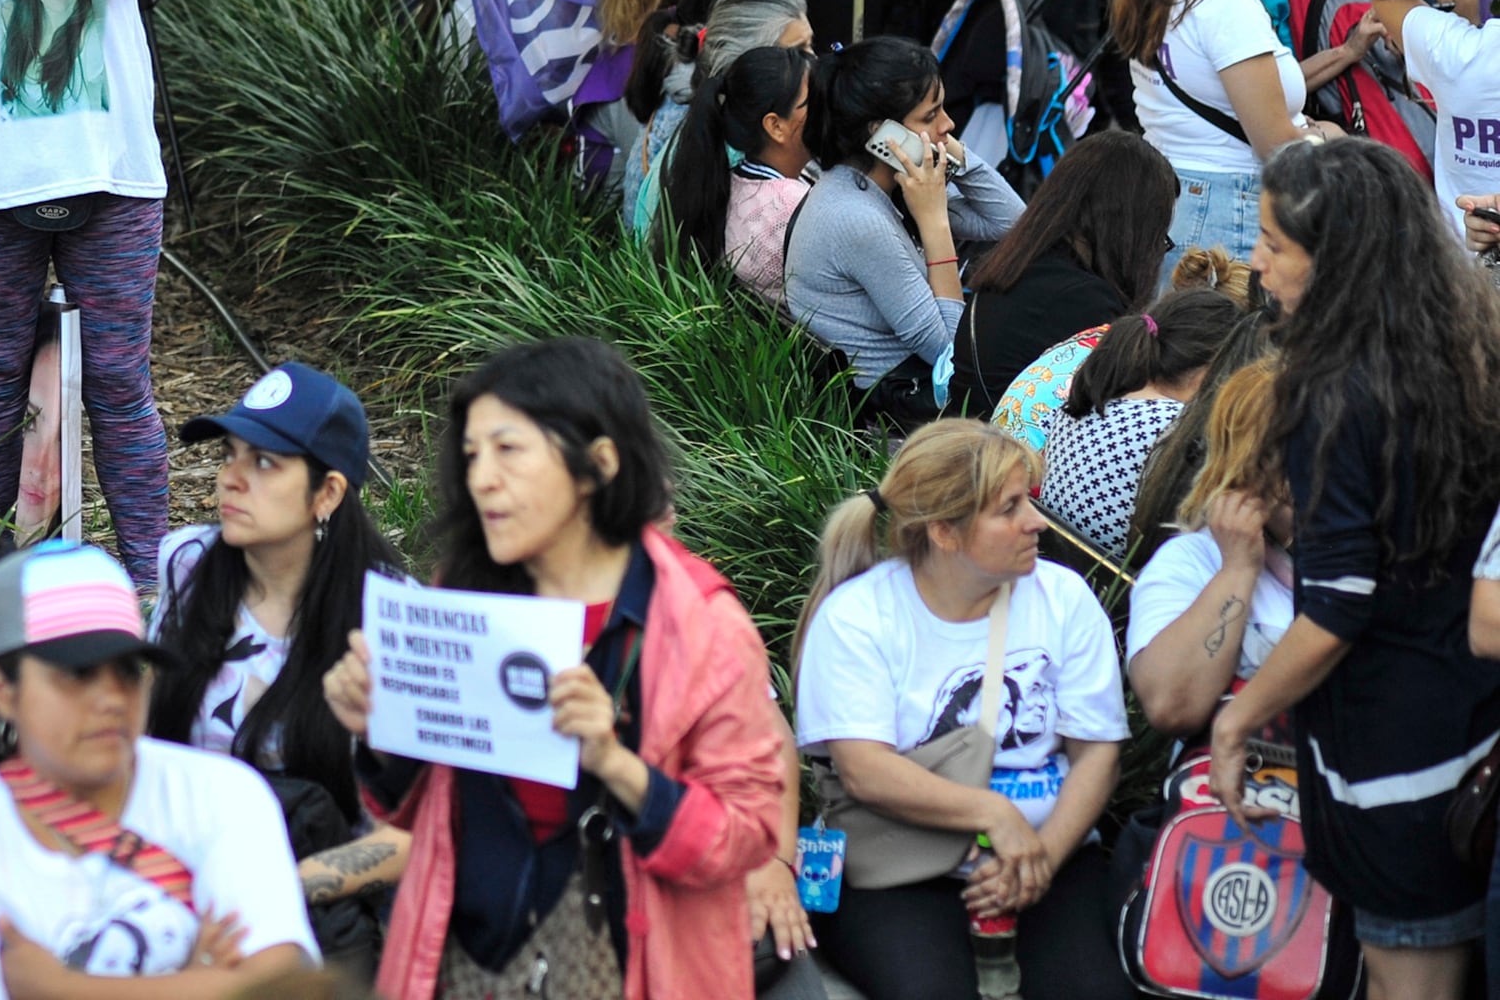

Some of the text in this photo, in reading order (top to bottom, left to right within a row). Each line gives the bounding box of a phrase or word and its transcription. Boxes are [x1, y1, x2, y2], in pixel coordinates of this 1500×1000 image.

[1454, 153, 1500, 168] Por la equid
